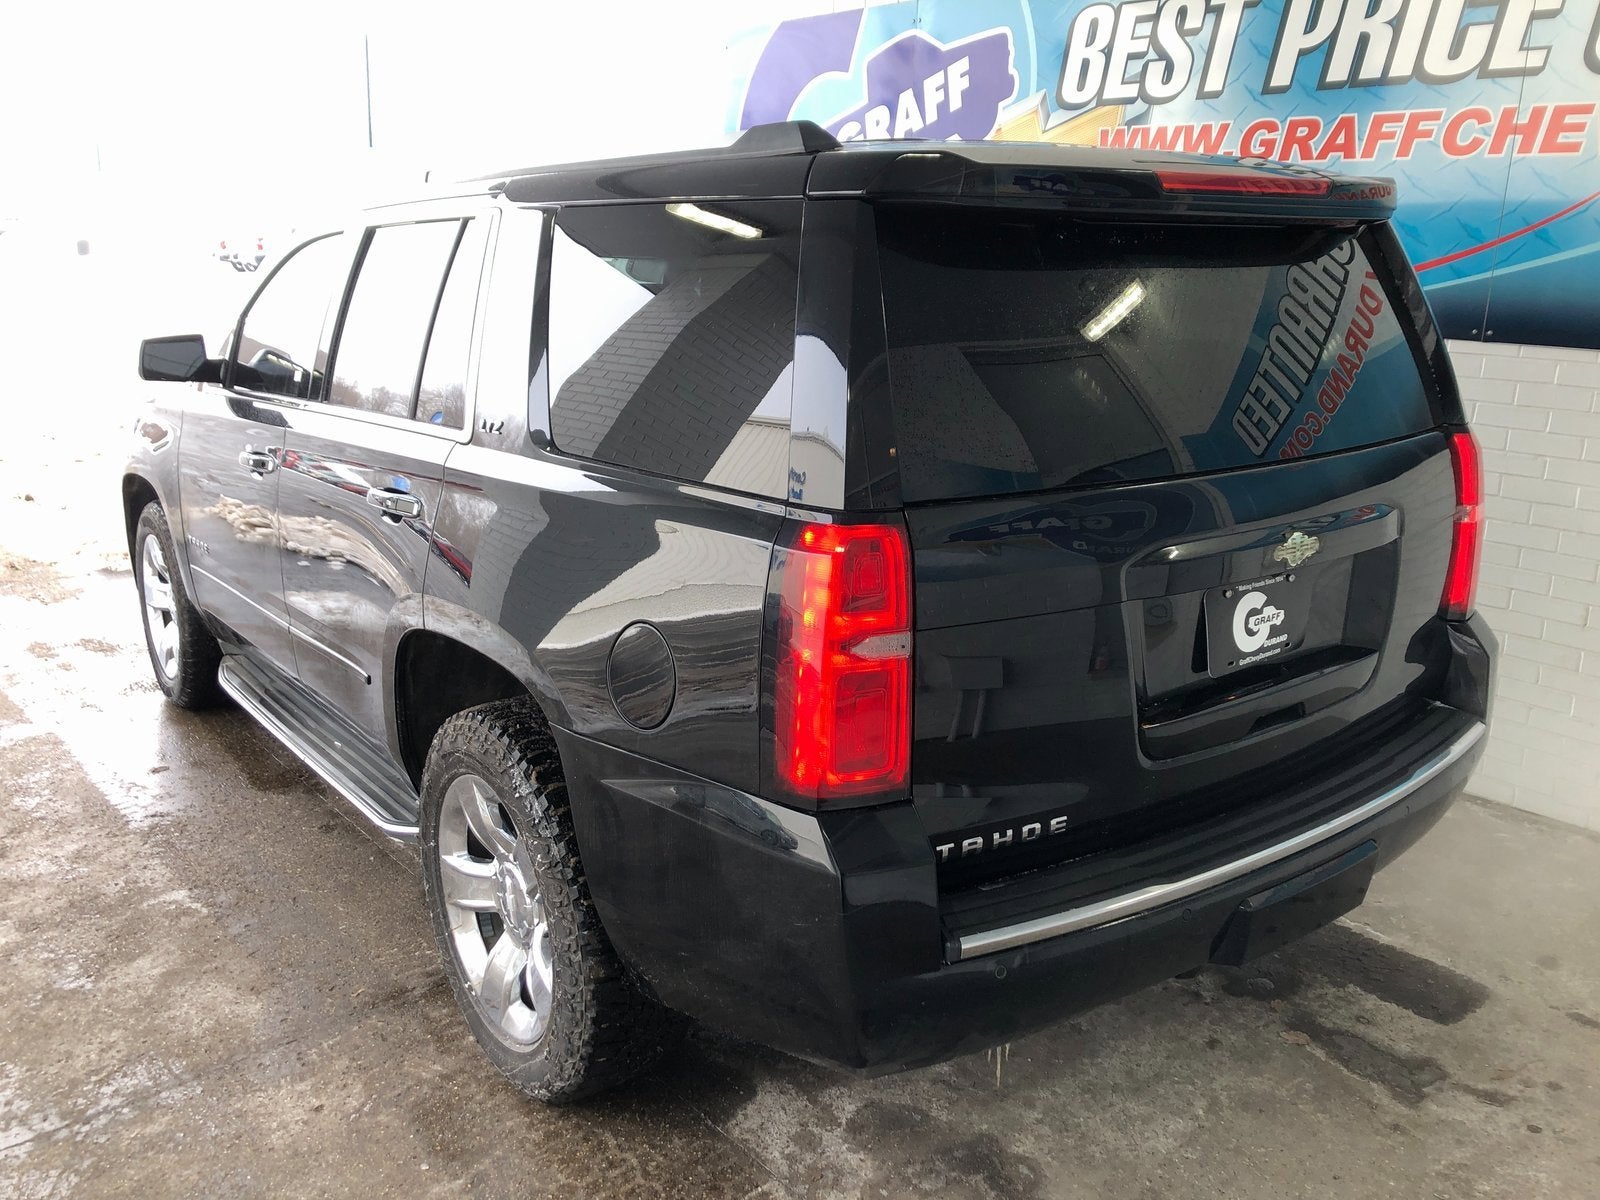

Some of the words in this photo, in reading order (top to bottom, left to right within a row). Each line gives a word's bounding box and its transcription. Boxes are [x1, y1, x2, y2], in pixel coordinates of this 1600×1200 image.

[1060, 0, 1261, 109] BEST
[1261, 0, 1565, 96] PRICE
[1254, 612, 1281, 626] GRAFF
[1263, 633, 1288, 648] DURAND
[935, 815, 1068, 862] TAHOE
